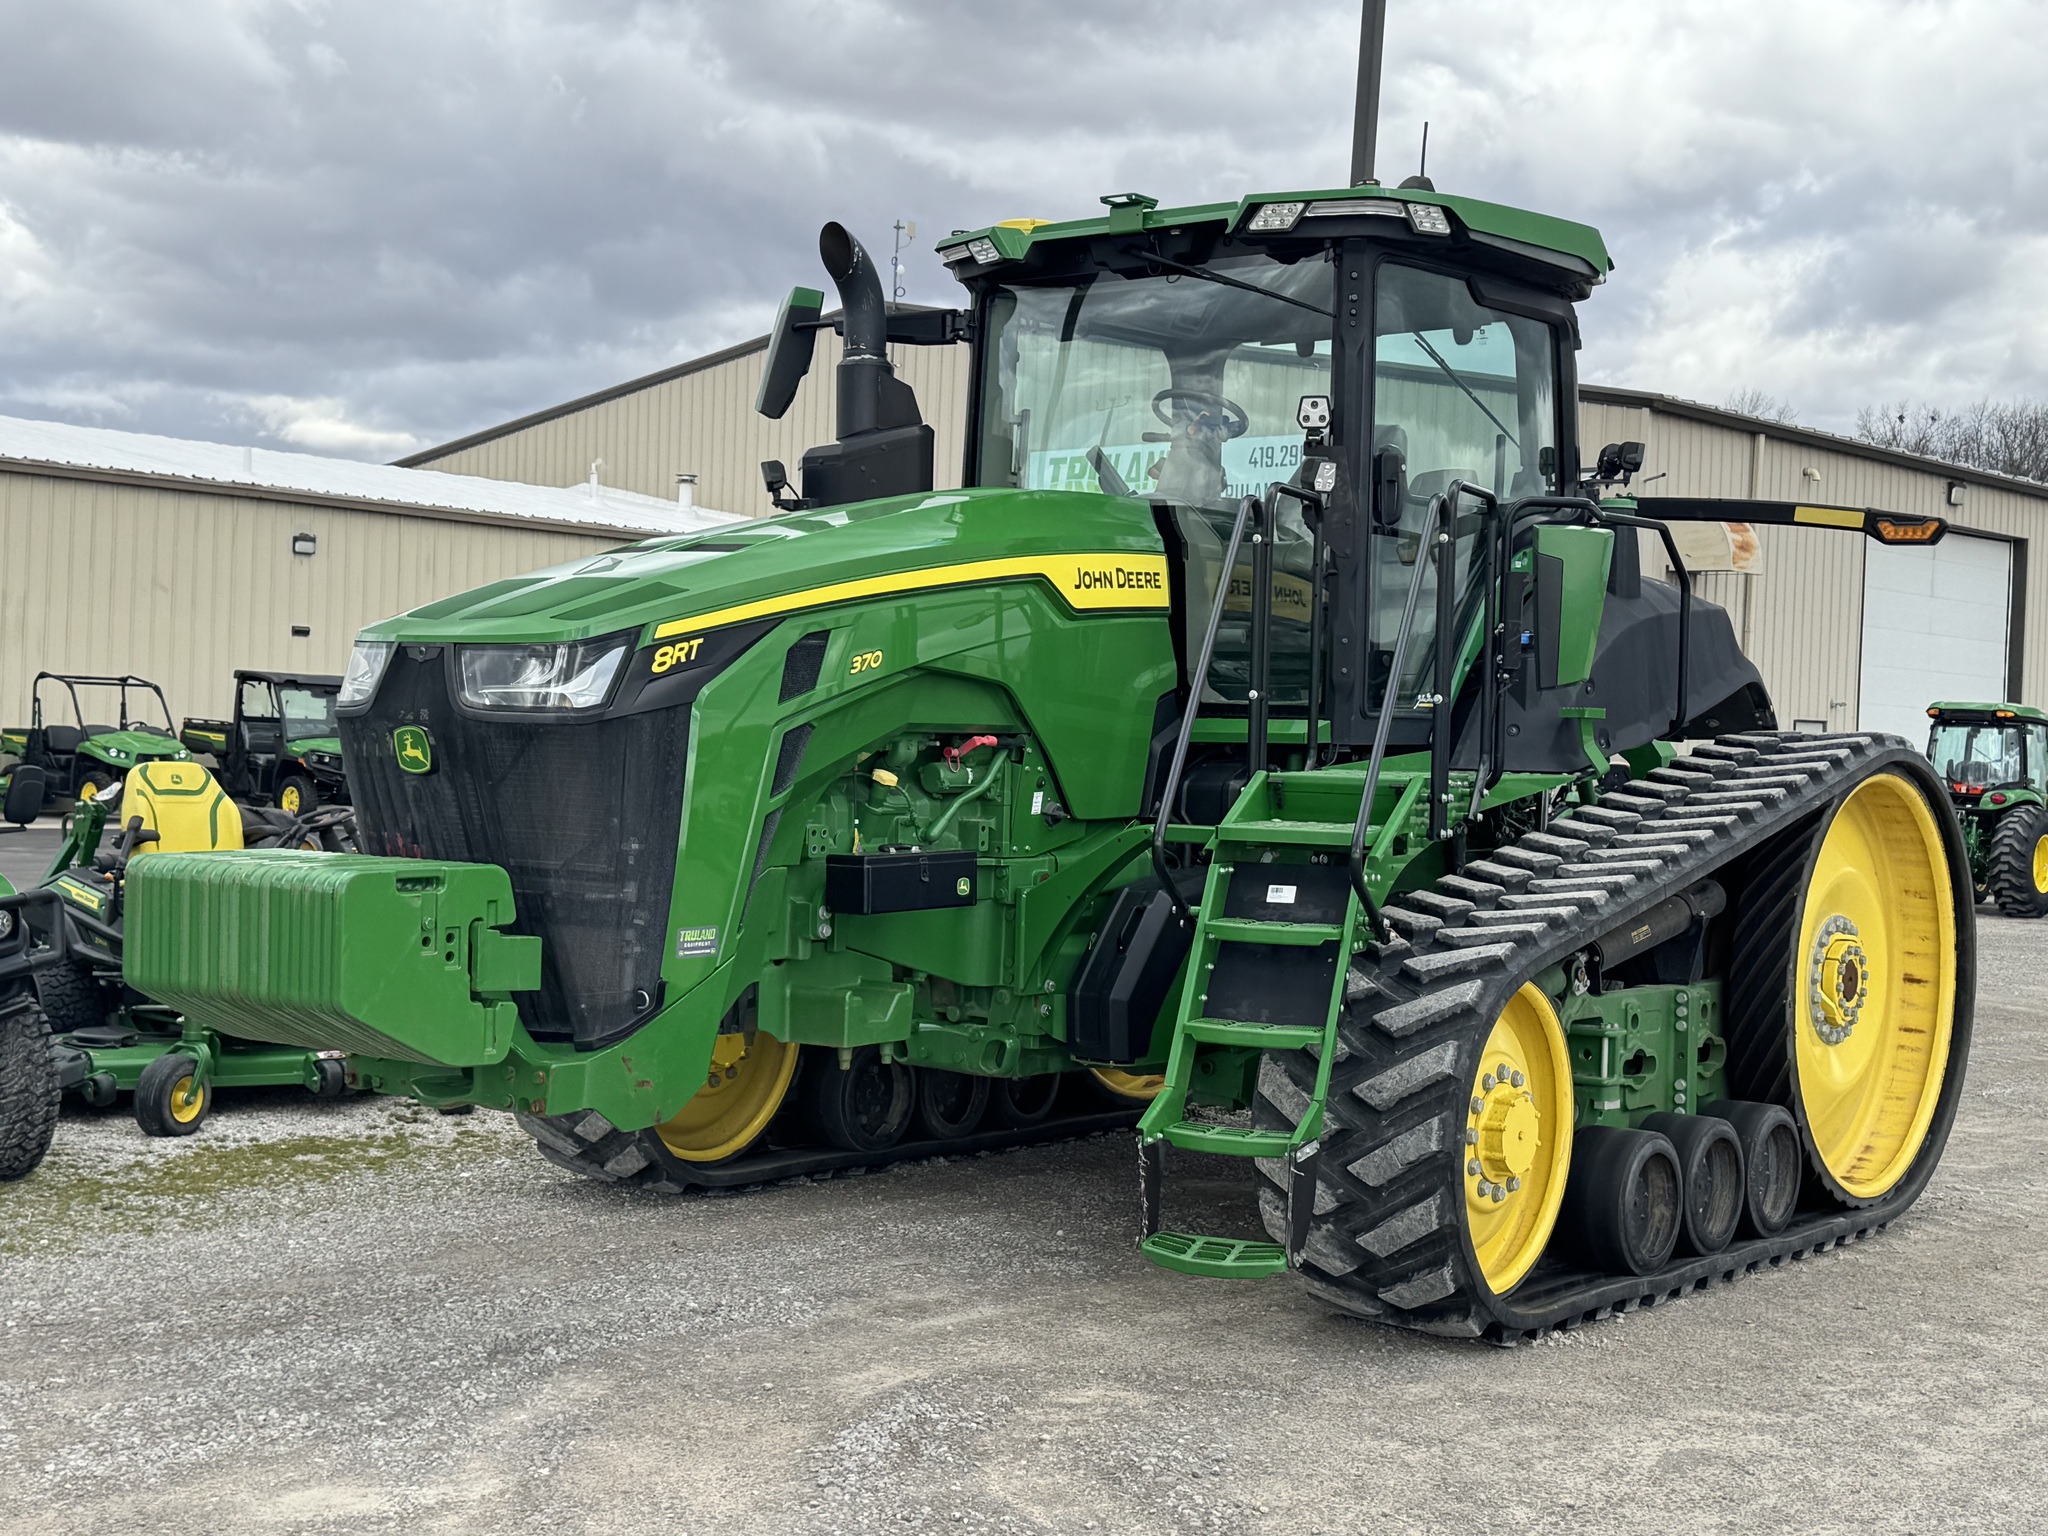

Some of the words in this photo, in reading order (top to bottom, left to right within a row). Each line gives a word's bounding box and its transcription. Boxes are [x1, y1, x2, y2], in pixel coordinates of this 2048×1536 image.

[1248, 445, 1303, 468] 419.29
[1074, 567, 1114, 590] JOHN
[1115, 567, 1162, 589] DEERE
[651, 638, 704, 674] 8RT
[849, 650, 883, 674] 370
[680, 928, 716, 941] TRULAND
